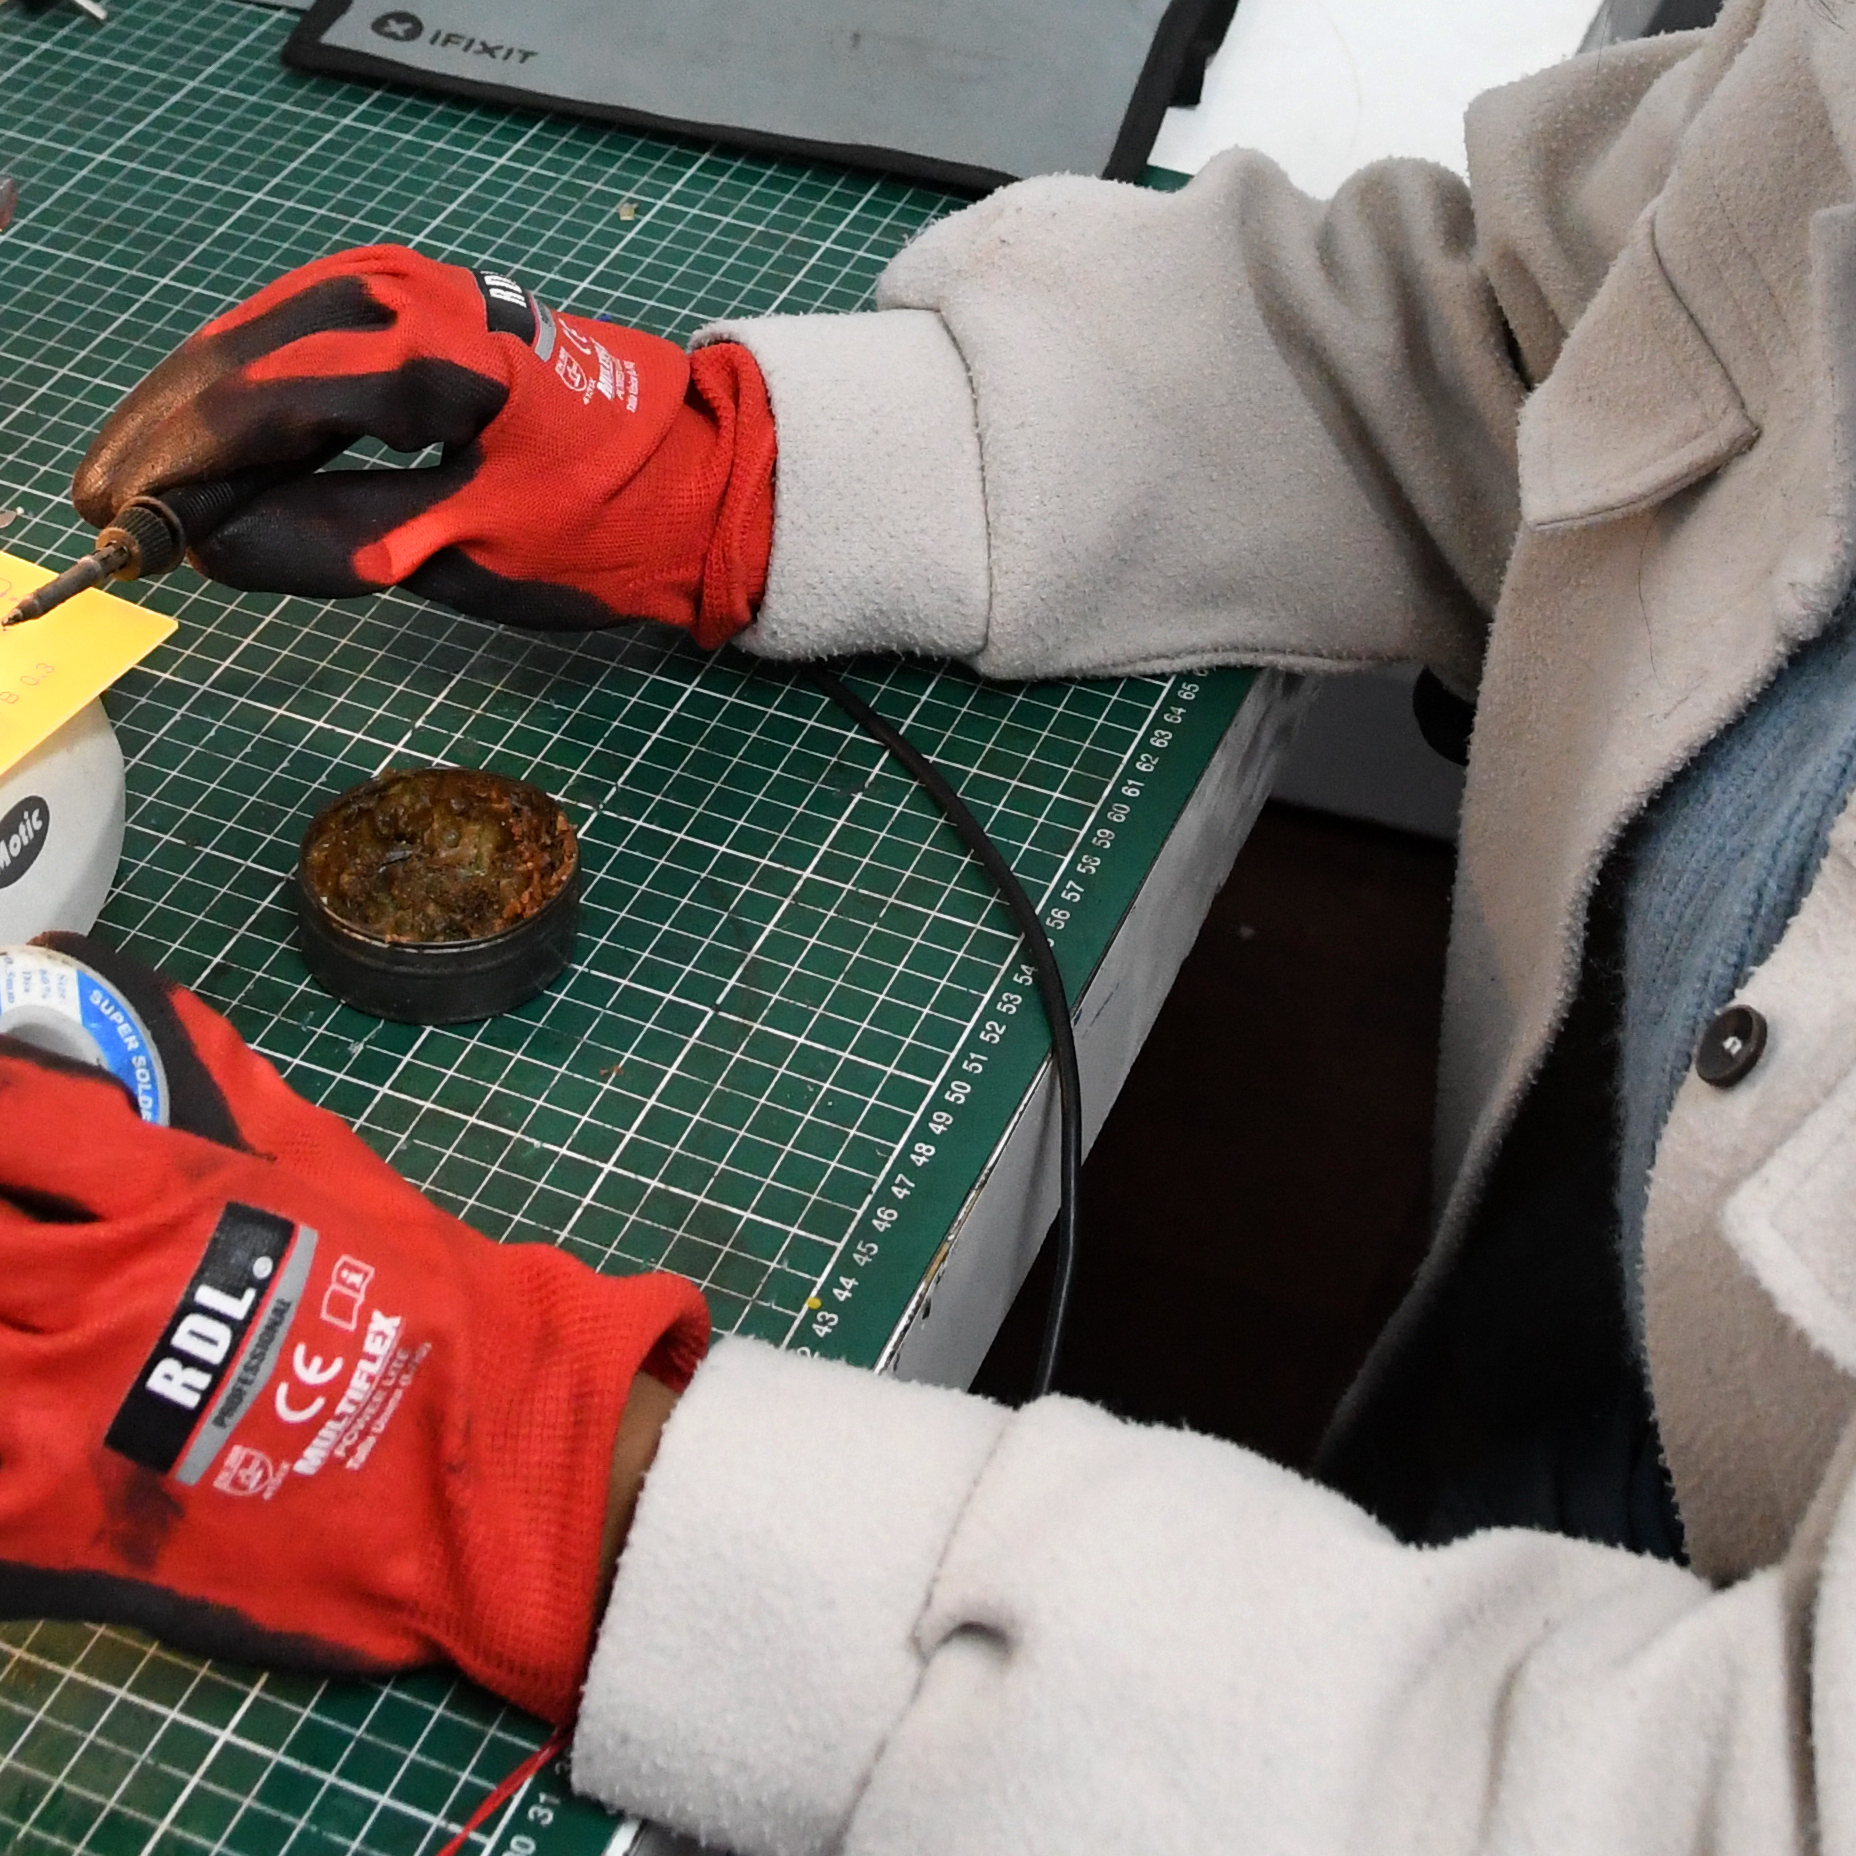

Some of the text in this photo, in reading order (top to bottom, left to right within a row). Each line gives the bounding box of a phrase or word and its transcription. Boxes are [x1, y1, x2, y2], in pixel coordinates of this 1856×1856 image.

[430, 28, 539, 65] IFIXIT
[480, 270, 527, 309] RD
[20, 662, 56, 687] 0.3
[1177, 682, 1198, 700] 65
[1163, 706, 1185, 724] 64
[1149, 729, 1172, 748] 63
[1135, 753, 1158, 772] 62
[1121, 779, 1144, 797] 61
[1106, 803, 1130, 823] 60
[1091, 828, 1114, 849] 59
[1060, 880, 1084, 903] 57
[1045, 907, 1070, 930] 56
[1012, 964, 1038, 987] 54
[995, 992, 1022, 1015] 53
[89, 988, 140, 1052] SUPER
[979, 1020, 1006, 1044] 52
[961, 1052, 988, 1074] 51
[944, 1080, 971, 1105] 50
[928, 1111, 953, 1135] 49
[909, 1142, 935, 1167] 48
[890, 1173, 915, 1200] 47
[871, 1206, 898, 1233] 46
[852, 1240, 878, 1267] 45
[832, 1275, 858, 1302] 44
[811, 1310, 838, 1338] 43
[275, 1342, 344, 1424] CE
[293, 1309, 402, 1476] MULTIFLEX
[528, 1792, 561, 1826] 31
